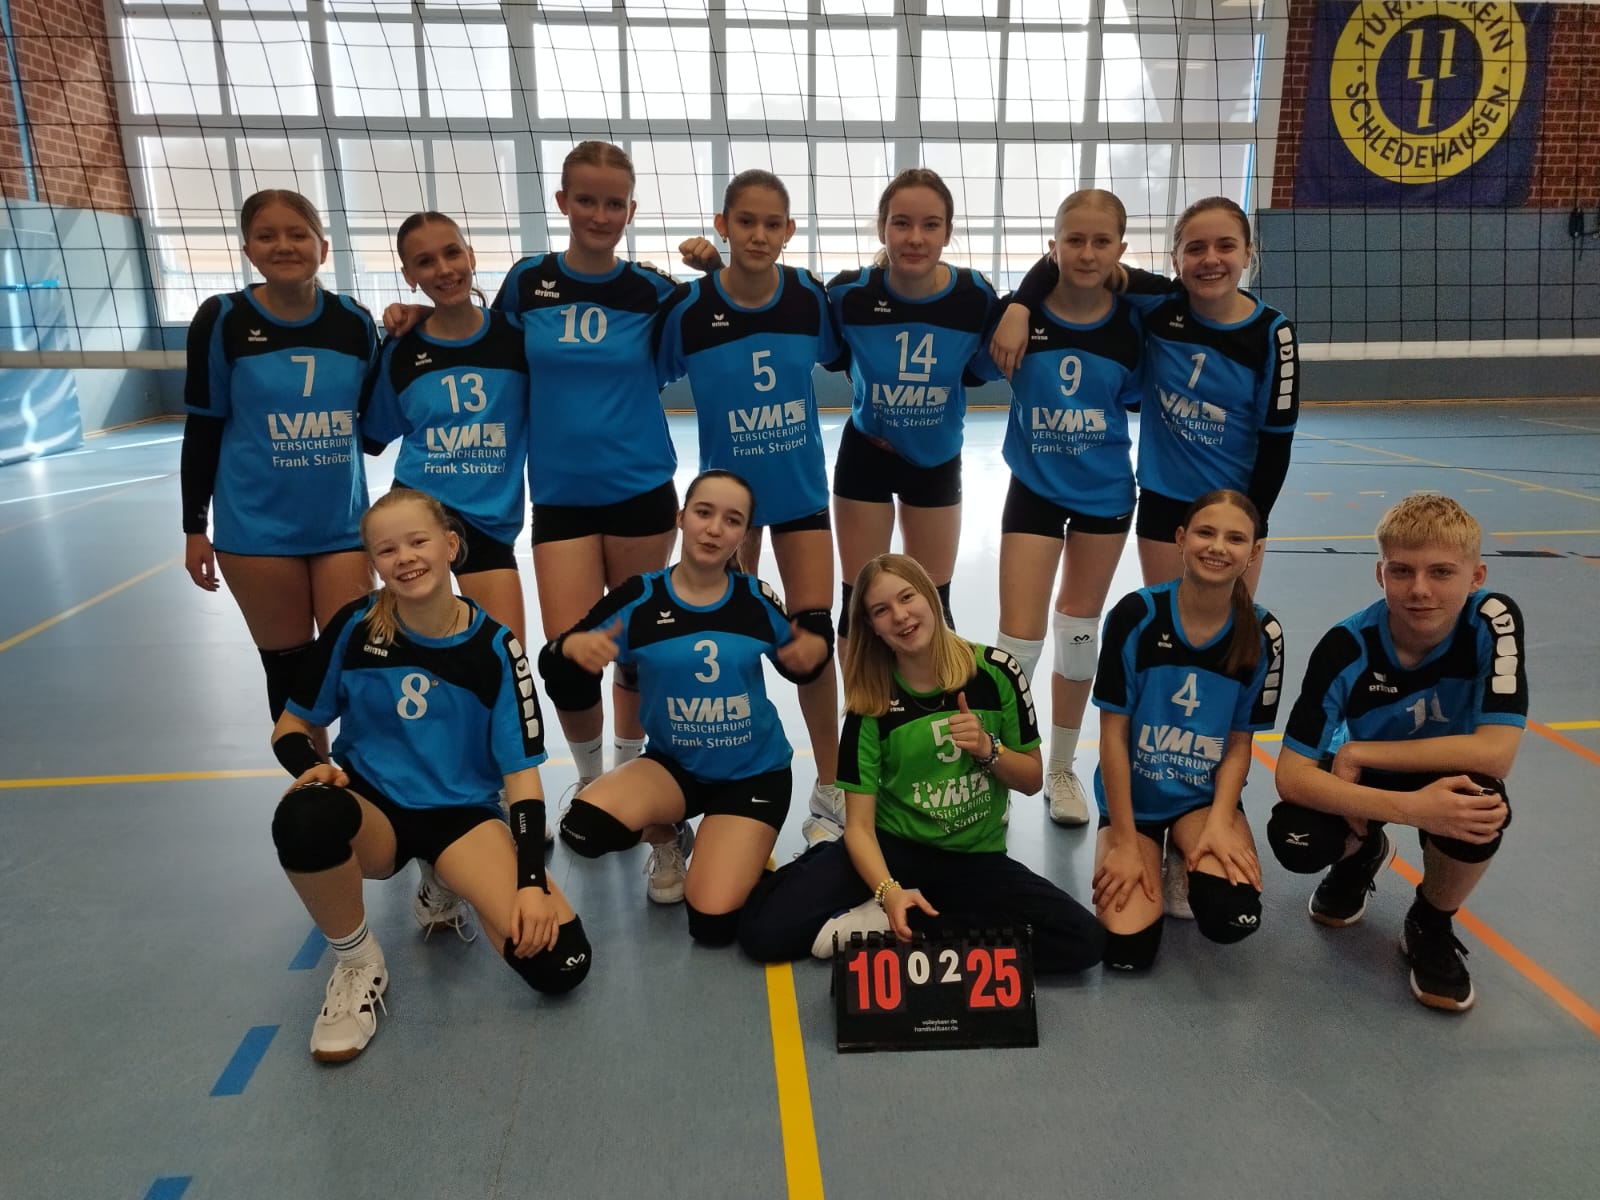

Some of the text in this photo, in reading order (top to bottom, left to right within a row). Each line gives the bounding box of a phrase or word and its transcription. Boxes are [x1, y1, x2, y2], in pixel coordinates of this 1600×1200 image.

[1355, 0, 1514, 52] TUREIN
[1346, 81, 1509, 168] SCHLEDEHAUSEN
[534, 288, 560, 299] erima
[558, 305, 608, 343] 10
[895, 331, 938, 374] 14
[291, 355, 316, 397] 7
[752, 350, 776, 392] 5
[1059, 355, 1082, 397] 9
[1188, 352, 1206, 390] 1
[441, 373, 487, 414] 13
[872, 383, 926, 407] LVM
[1159, 388, 1200, 419] VM
[267, 412, 332, 440] LVM
[728, 403, 784, 433] LVM
[731, 421, 806, 443] VERSICHERUNG
[902, 416, 945, 428] Strötzel
[1032, 406, 1084, 433] LVM
[272, 437, 353, 451] VERSICHERUNG
[426, 423, 484, 451] LVM
[732, 435, 808, 459] Frank Strötzel
[1031, 443, 1062, 454] Frank
[272, 452, 352, 468] Frank Strötze
[424, 462, 505, 475] Frank Strötzel
[693, 639, 720, 684] 3
[396, 672, 431, 720] 8
[667, 697, 724, 722] LVM
[1171, 673, 1200, 717] 4
[671, 719, 751, 733] VERSICHERUNG
[672, 732, 752, 749] Frank Strötzel
[931, 718, 963, 763] 5
[1138, 725, 1192, 755] LVM
[1133, 761, 1164, 781] Frank
[912, 775, 970, 808] LVM
[848, 948, 1021, 1010] 10 0 2 25
